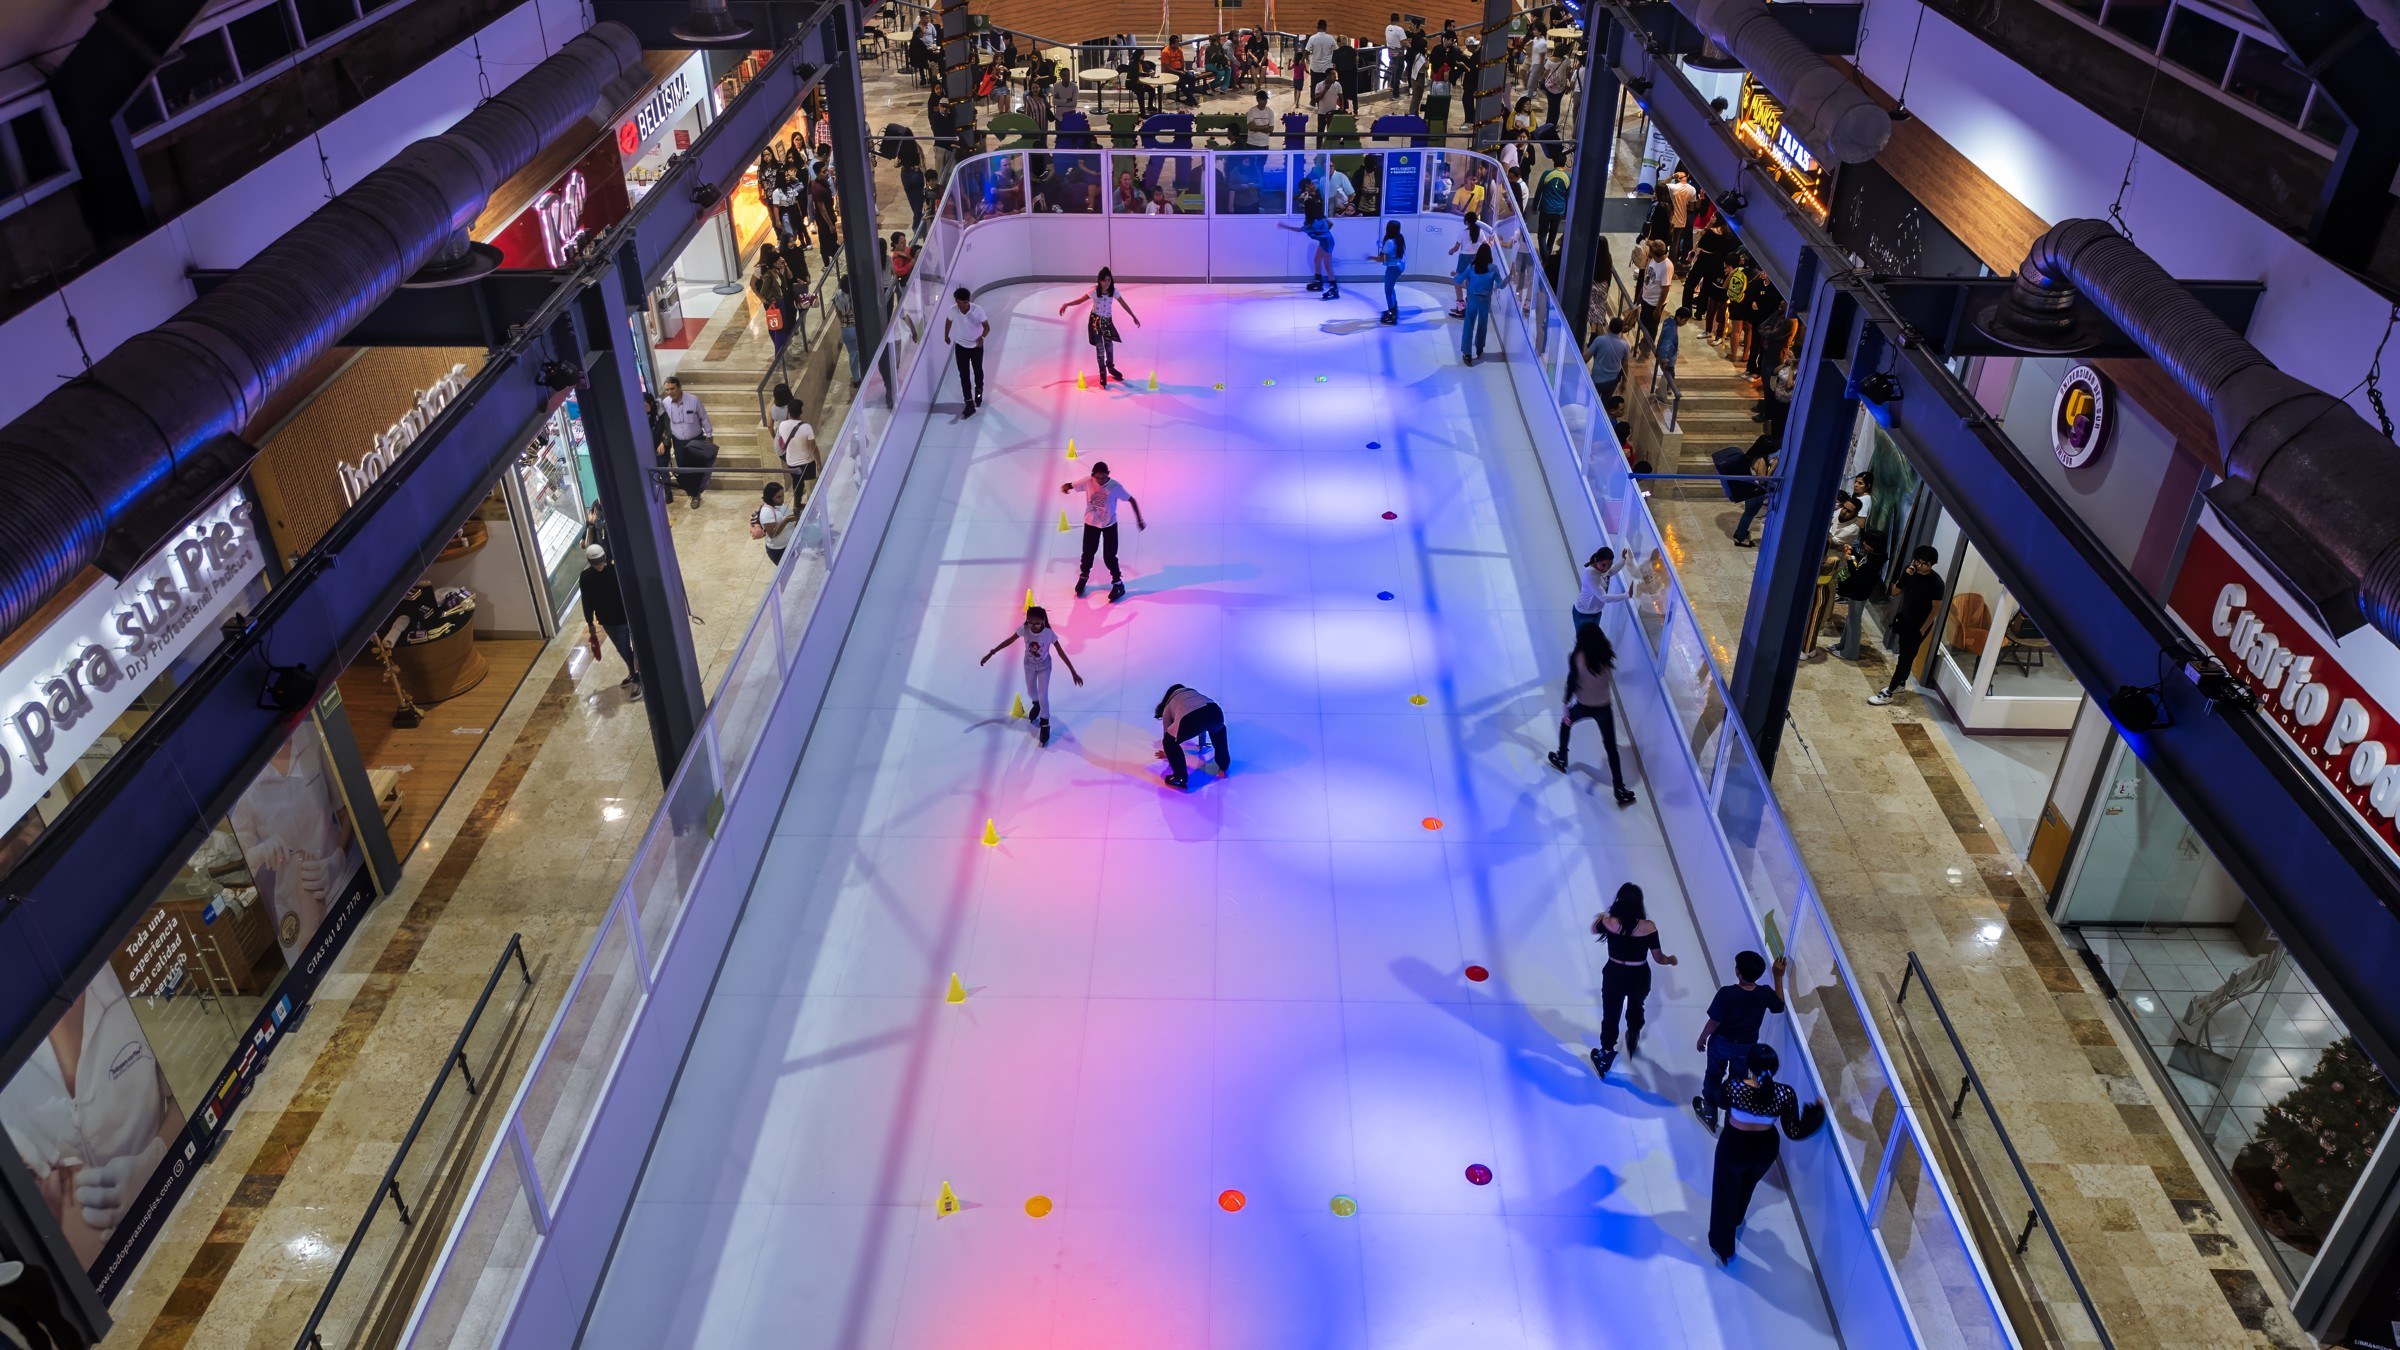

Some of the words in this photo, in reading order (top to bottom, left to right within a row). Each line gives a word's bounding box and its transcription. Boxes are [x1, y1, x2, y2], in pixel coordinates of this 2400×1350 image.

[1751, 94, 1782, 139] MONKEY
[1778, 124, 1812, 171] PAPAS
[2060, 368, 2096, 395] UNIVERSIDAD
[2094, 408, 2102, 429] SUR
[12, 643, 122, 774] para
[116, 576, 180, 656] sus
[174, 501, 253, 593] Pies
[2212, 583, 2329, 727] Cuarto
[125, 654, 149, 681] Dry
[126, 930, 149, 958] Toda
[148, 909, 166, 932] una
[129, 917, 178, 981] experiencia
[306, 945, 326, 974] CITAS
[324, 929, 336, 947] 961
[139, 976, 152, 993] en
[151, 933, 183, 978] calidad
[146, 995, 154, 1010] y
[154, 952, 187, 999] servicio
